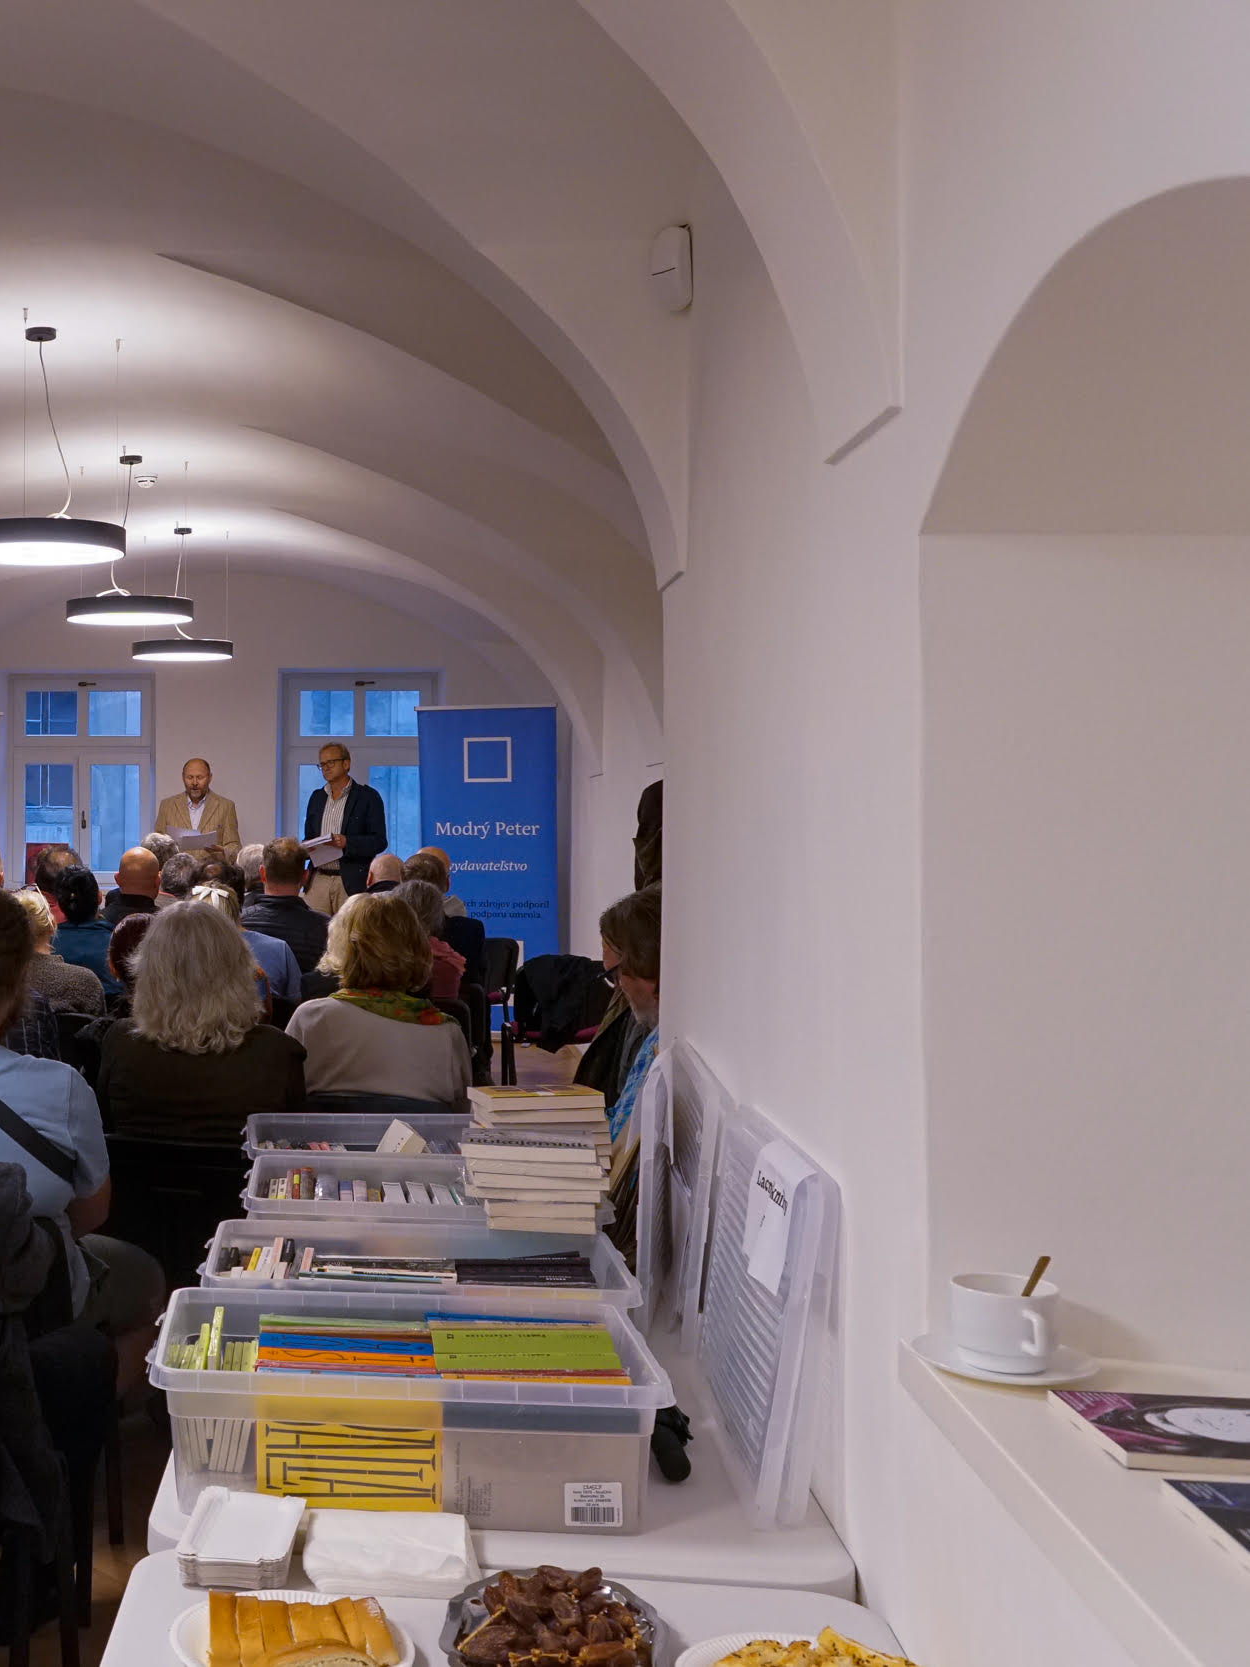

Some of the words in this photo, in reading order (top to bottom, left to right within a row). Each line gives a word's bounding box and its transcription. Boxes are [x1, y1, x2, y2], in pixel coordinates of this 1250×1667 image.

[435, 821, 490, 839] Modrý
[495, 821, 540, 836] Peter
[449, 860, 527, 873] vydavateľstvo
